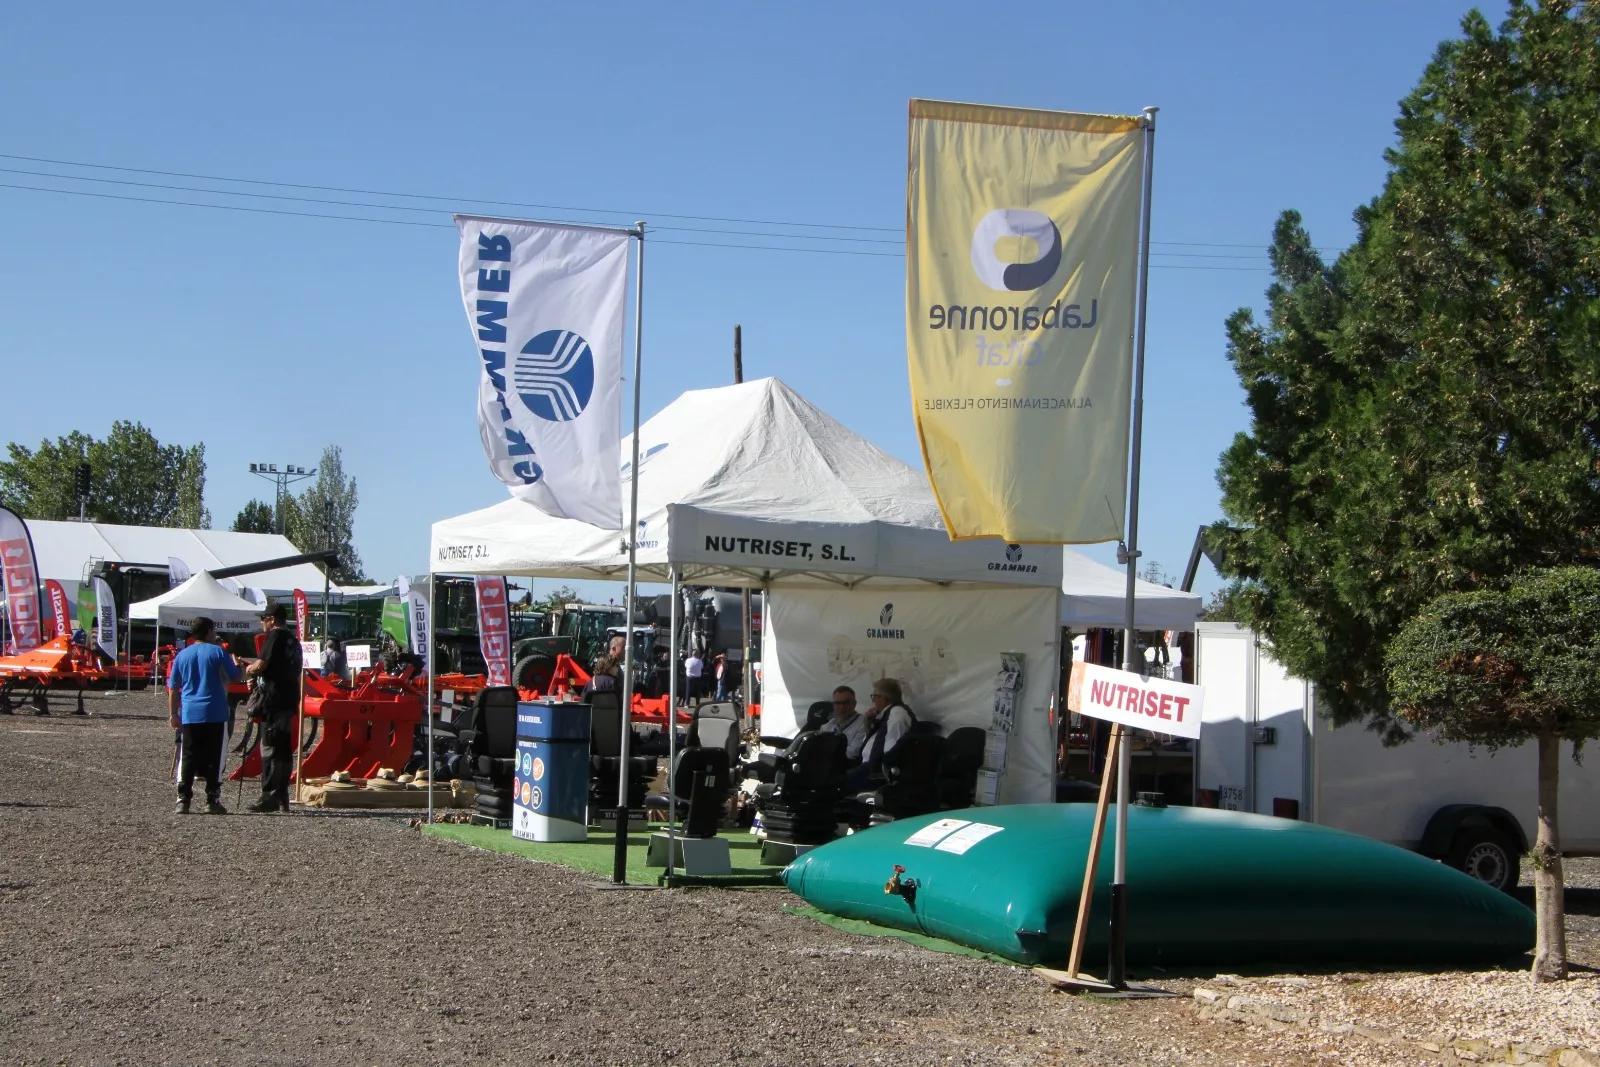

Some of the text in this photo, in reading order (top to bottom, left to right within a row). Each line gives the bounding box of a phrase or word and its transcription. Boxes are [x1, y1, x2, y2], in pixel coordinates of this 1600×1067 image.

[438, 544, 490, 561] NUTRISET, S.L.
[705, 535, 856, 563] NUTRISET, S.L.
[988, 562, 1038, 573] GRAMMER
[866, 628, 905, 639] GRAMMER
[1090, 678, 1190, 722] NUTRISET
